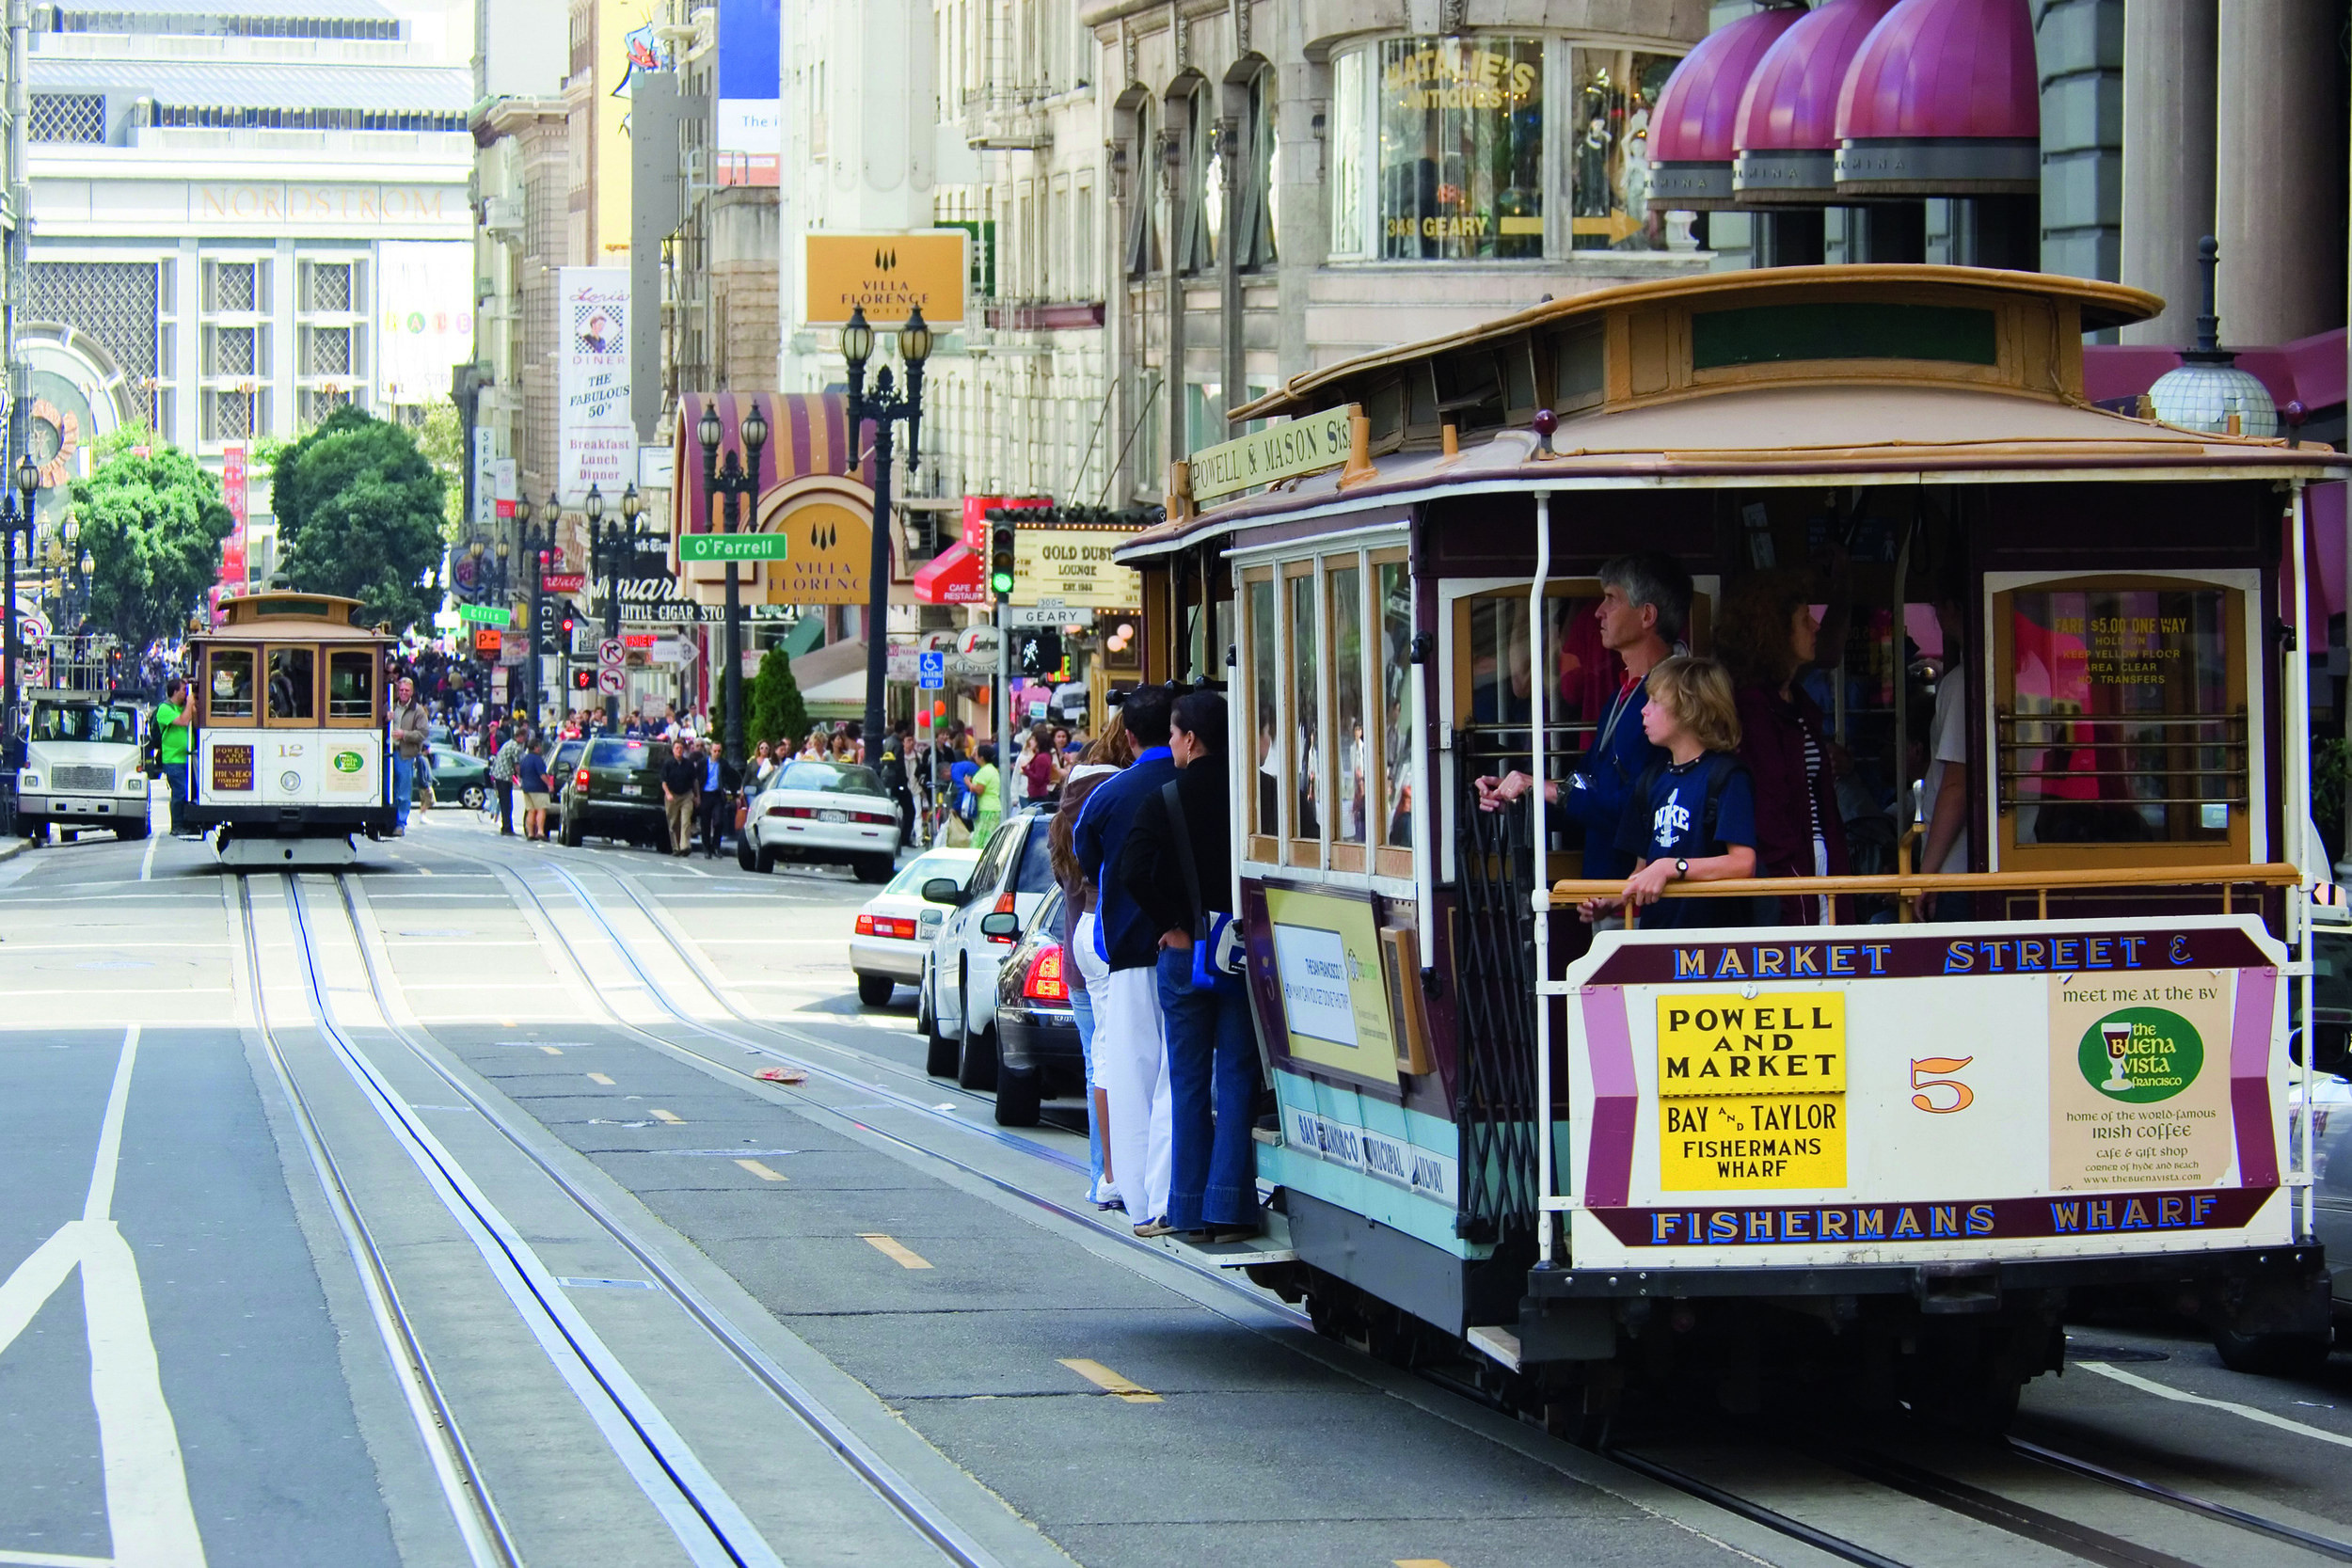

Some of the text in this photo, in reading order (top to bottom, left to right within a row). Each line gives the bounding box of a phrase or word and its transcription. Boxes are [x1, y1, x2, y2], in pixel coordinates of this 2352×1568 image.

[1387, 48, 1535, 94] NATALIE'S
[1406, 87, 1502, 109] ANTIQUES
[742, 116, 768, 127] The
[201, 186, 444, 219] NORDSTROM
[1387, 216, 1488, 238] 349 GEARY
[863, 280, 909, 291] VILLA
[841, 293, 929, 305] FLORENCE
[572, 356, 626, 365] DINER
[588, 372, 612, 387] THE
[569, 385, 630, 406] FABULOUS
[588, 402, 612, 418] 50's
[569, 439, 630, 450] Breakfast
[581, 453, 618, 465] Lunch
[1193, 450, 1242, 491] POWELL
[1248, 443, 1257, 475] &
[1264, 425, 1318, 471] MASON
[580, 468, 621, 480] Dinner
[695, 538, 772, 555] O'Farrell
[1042, 546, 1077, 560] GOLD
[795, 562, 851, 574] VILLA
[1058, 565, 1097, 576] LOUNGE
[769, 578, 864, 591] FLORENC
[949, 583, 971, 592] CAFE
[621, 604, 725, 620] LITTLE CIGAR STO
[1025, 611, 1078, 622] GEARY
[2056, 618, 2186, 634] FARE $5.00 ONE WAY
[2095, 637, 2146, 645] HOLD ON
[2063, 649, 2181, 658] KEEP YELLOW FLOOR
[920, 670, 943, 678] PARKING
[2085, 662, 2157, 672] AREA CLEAR
[2078, 674, 2166, 684] NO TRANSFERS
[278, 744, 304, 758] 12
[1654, 804, 1690, 831] NIKE
[1673, 943, 1891, 980] MARKET
[1944, 935, 2146, 974] STREET
[2063, 986, 2217, 1002] meet me at the BV
[1669, 1007, 1833, 1032] POWELL
[2132, 1022, 2156, 1035] the
[1712, 1034, 1793, 1052] AND
[1666, 1054, 1836, 1078] MARKET
[1911, 1055, 1974, 1114] 5
[1668, 1106, 1708, 1132] BAY
[1751, 1103, 1836, 1131] TAYLOR
[2067, 1109, 2216, 1121] home of the world-famous
[1297, 1114, 1316, 1147] SAN
[2137, 1123, 2191, 1140] coffee
[1683, 1138, 1821, 1158] FISHERMANS
[2096, 1148, 2122, 1158] cafe
[2125, 1148, 2133, 1157] &
[2160, 1146, 2188, 1157] shop
[1717, 1161, 1788, 1178] WHARF
[2121, 1163, 2131, 1172] of
[2132, 1162, 2153, 1172] hyde
[2156, 1161, 2173, 1169] and
[1650, 1195, 2218, 1243] FISHERMANS WHARF
